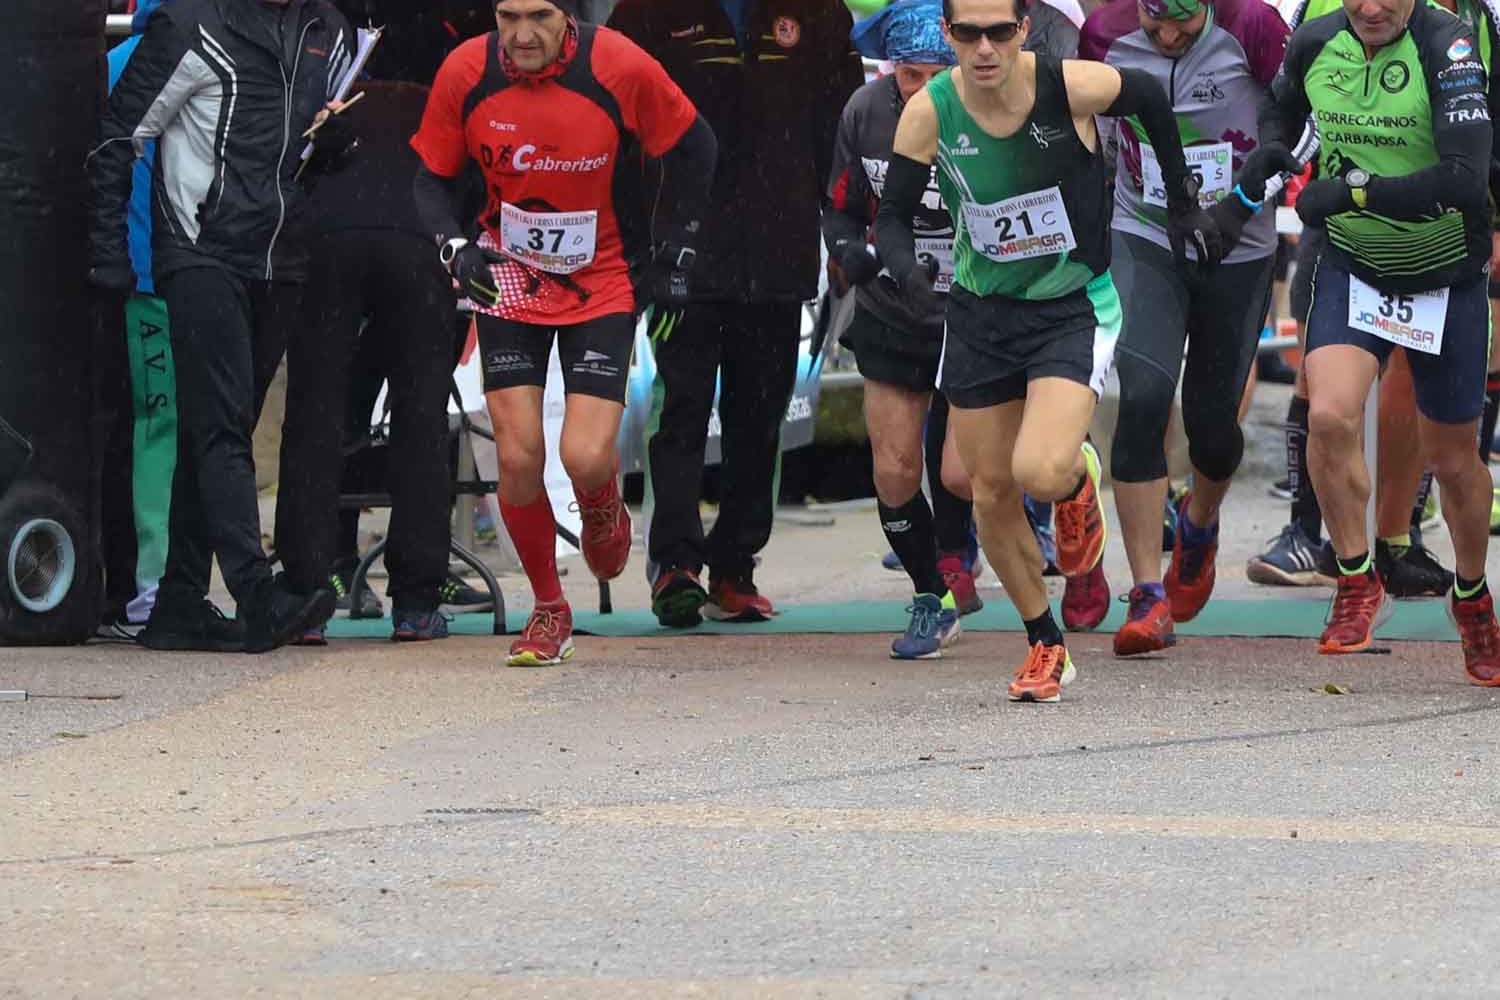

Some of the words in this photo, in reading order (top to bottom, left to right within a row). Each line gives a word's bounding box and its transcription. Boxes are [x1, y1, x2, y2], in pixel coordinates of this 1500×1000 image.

[1317, 109, 1417, 128] CORRECAMINOS
[1325, 131, 1408, 148] CARBAJOSA
[994, 210, 1035, 242] 21
[527, 228, 566, 253] 37
[981, 232, 1067, 257] JOMISAGA
[1378, 295, 1414, 324] 35
[1355, 310, 1435, 345] JOMISAGA
